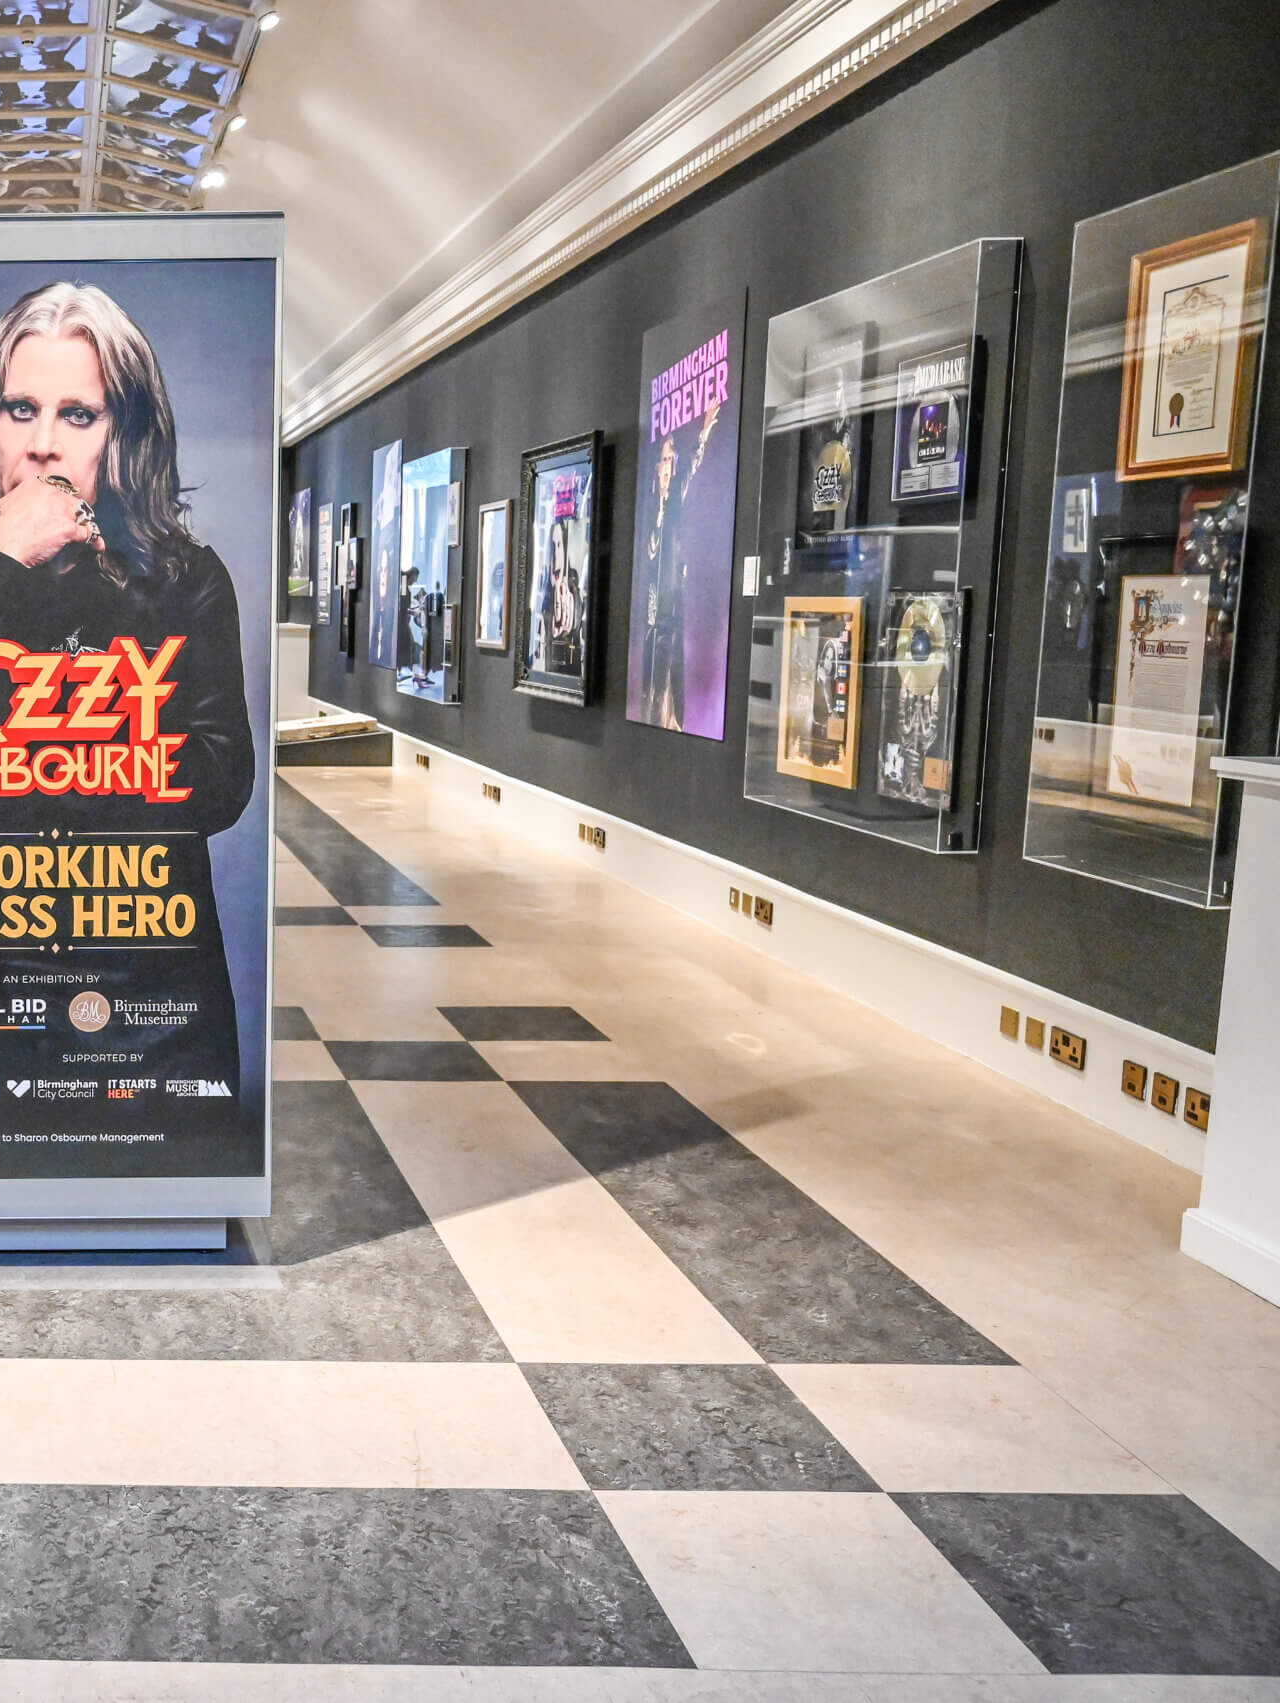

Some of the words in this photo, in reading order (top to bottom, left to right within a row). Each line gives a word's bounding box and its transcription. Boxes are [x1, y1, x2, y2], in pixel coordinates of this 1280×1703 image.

[650, 328, 729, 403] BIRMINGHAM
[649, 361, 729, 443] FOREVER
[73, 894, 196, 938] HERO
[3, 975, 19, 983] AN
[22, 974, 83, 983] EXHIBITION
[86, 974, 100, 983] BY
[11, 998, 47, 1014] BID
[114, 999, 198, 1016] Birmingham
[124, 1012, 188, 1025] Museums
[62, 1053, 126, 1063] SUPPORTED
[129, 1053, 144, 1062] BY
[37, 1079, 98, 1091] Birmingham
[108, 1079, 117, 1089] IT
[119, 1079, 157, 1089] STARTS
[166, 1084, 198, 1093] MUSIC
[37, 1089, 57, 1100] City
[58, 1089, 95, 1099] Council
[108, 1090, 135, 1099] HERE
[2, 1134, 11, 1142] to
[14, 1133, 48, 1142] Sharon
[51, 1133, 96, 1143] Osbourne
[99, 1133, 164, 1145] Management
